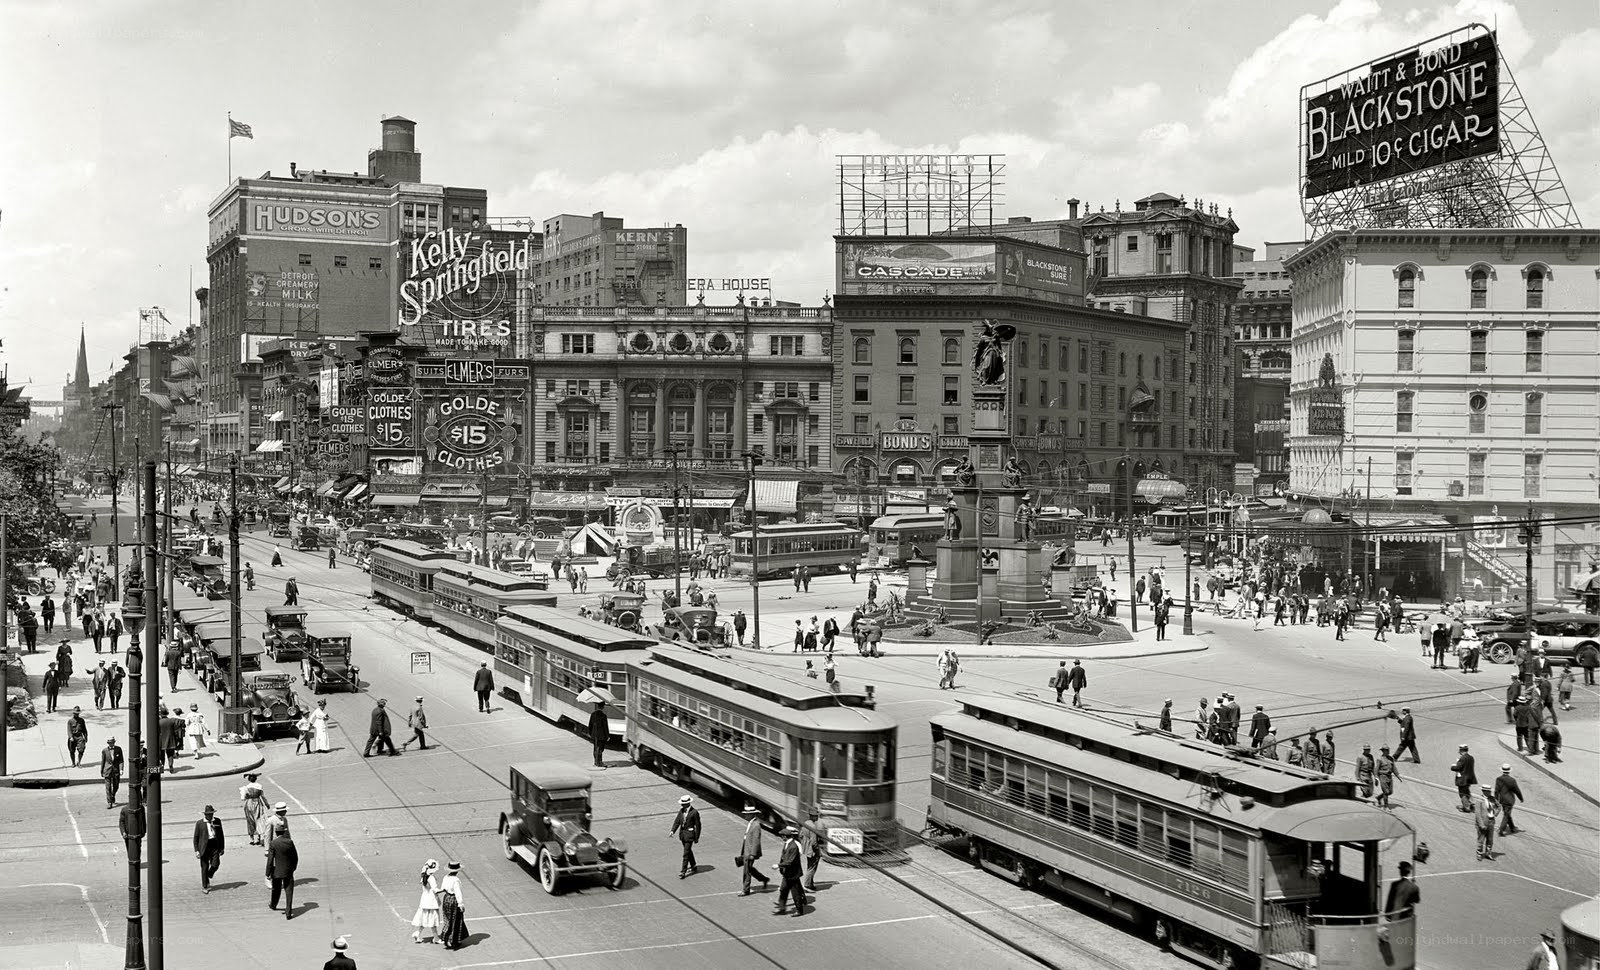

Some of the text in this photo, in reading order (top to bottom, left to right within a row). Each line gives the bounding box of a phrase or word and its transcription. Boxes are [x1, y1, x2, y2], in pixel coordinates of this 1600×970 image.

[1340, 42, 1461, 100] WAITT & BOND
[1308, 61, 1488, 161] BLACKSTONE
[1332, 149, 1365, 170] MILD
[1409, 114, 1494, 157] CIGAR
[864, 155, 975, 174] HENKEL'S
[884, 181, 963, 200] FLOUR
[1364, 192, 1381, 206] LEE
[1393, 183, 1420, 200] CADY
[256, 205, 380, 231] HUDSON'S
[858, 209, 977, 219] ALWAYS THE BEST
[280, 225, 313, 233] GROWS
[336, 228, 369, 236] DETROIT
[616, 231, 674, 243] KERN'S
[858, 267, 963, 276] CASCADE
[1027, 259, 1067, 273] BLACKSTONE
[282, 272, 314, 281] DETROIT
[398, 239, 529, 326] Springfield
[1050, 271, 1067, 280] SURE
[276, 280, 319, 289] CREAMERY
[722, 278, 769, 290] HOUSE
[282, 289, 313, 300] MILK
[439, 319, 511, 336] TIRES
[435, 338, 509, 346] MADE TO MAKE GOOD
[417, 361, 524, 383] SUITS ELMER'S FURS
[374, 394, 405, 403] GOLDE
[440, 395, 500, 416] GOLDE
[331, 407, 364, 418] GOLDE
[369, 406, 412, 420] CLOTHES
[331, 423, 365, 433] CLOTHES
[376, 422, 403, 441] $15
[451, 425, 487, 445] $15
[884, 435, 930, 449] BOND'S
[438, 450, 503, 473] CLOTHES
[1176, 879, 1211, 899] 7126
